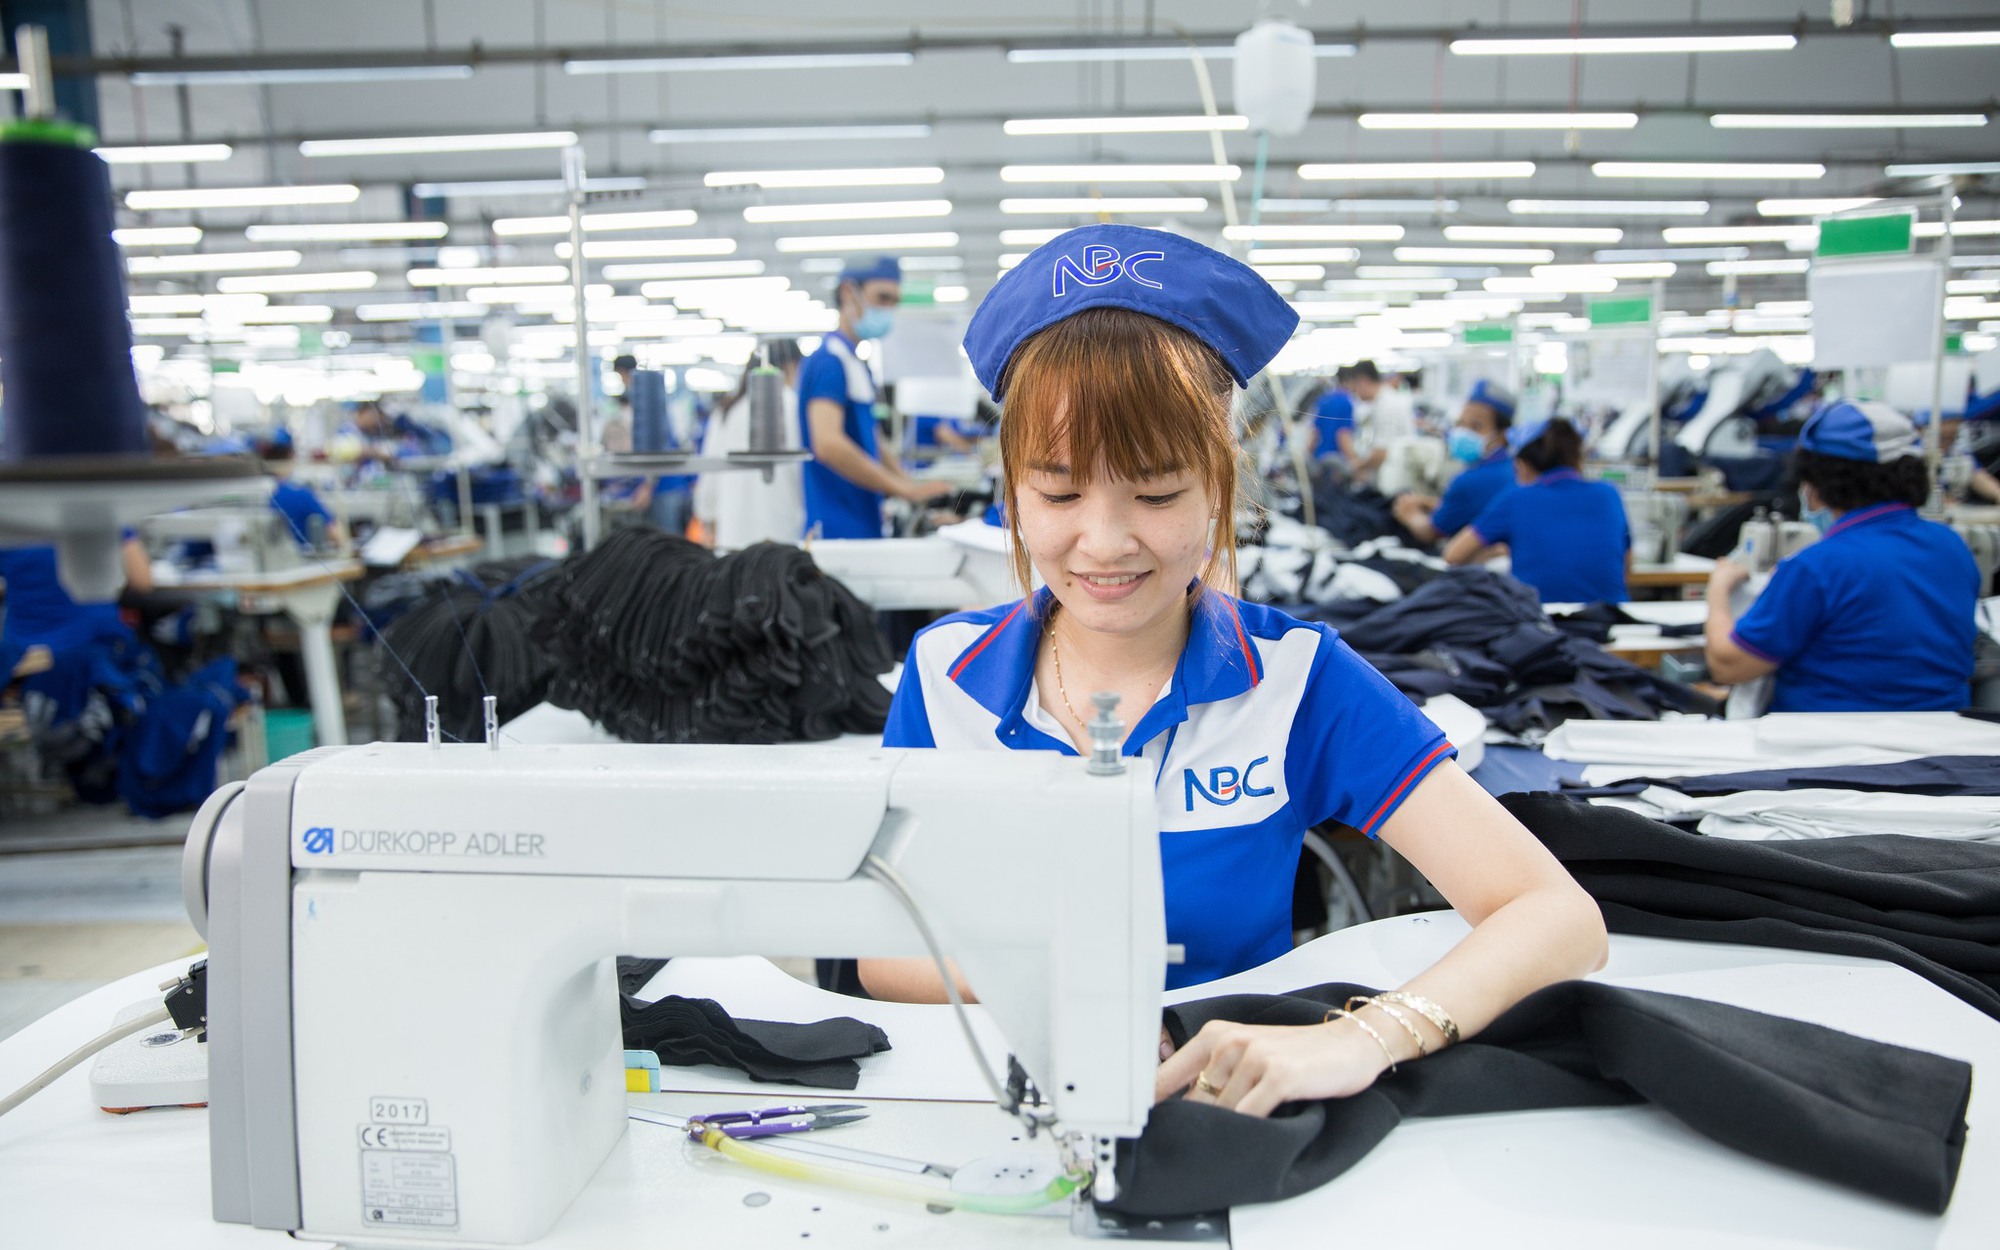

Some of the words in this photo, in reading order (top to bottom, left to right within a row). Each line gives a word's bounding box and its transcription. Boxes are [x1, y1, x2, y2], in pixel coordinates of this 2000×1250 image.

[1053, 245, 1164, 297] NBC
[1184, 755, 1275, 811] NBC
[341, 830, 457, 854] DÜRKOPP
[465, 832, 546, 856] ADLER
[376, 1103, 422, 1119] 2017
[362, 1127, 387, 1147] CE
